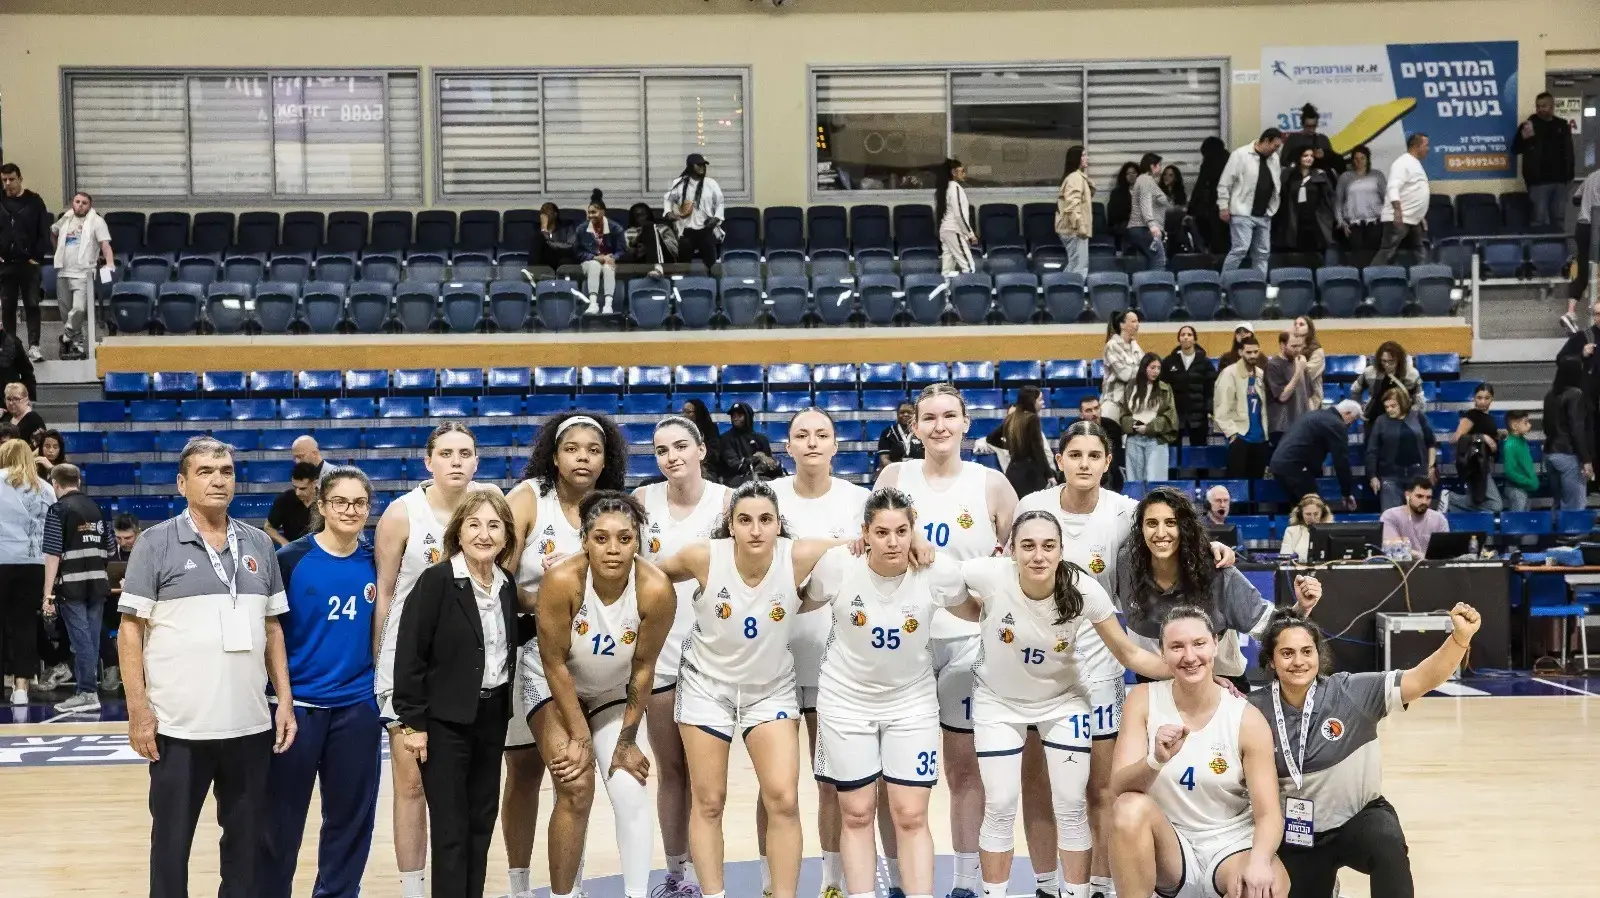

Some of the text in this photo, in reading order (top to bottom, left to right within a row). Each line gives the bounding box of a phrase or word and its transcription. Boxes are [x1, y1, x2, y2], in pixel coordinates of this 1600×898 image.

[1294, 65, 1353, 75] אורטופדיה
[1401, 60, 1495, 78] המדרסים
[1423, 80, 1498, 98] הטובים
[1437, 99, 1502, 117] בעולם
[1251, 399, 1258, 413] 7
[924, 523, 950, 547] 10
[328, 595, 357, 620] 24
[744, 617, 757, 639] 8
[871, 627, 901, 650] 35
[592, 634, 615, 656] 12
[1021, 648, 1045, 664] 15
[962, 697, 971, 720] 1
[1094, 705, 1113, 729] 11
[1069, 714, 1090, 739] 15
[916, 751, 937, 776] 35
[1179, 766, 1195, 790] 4
